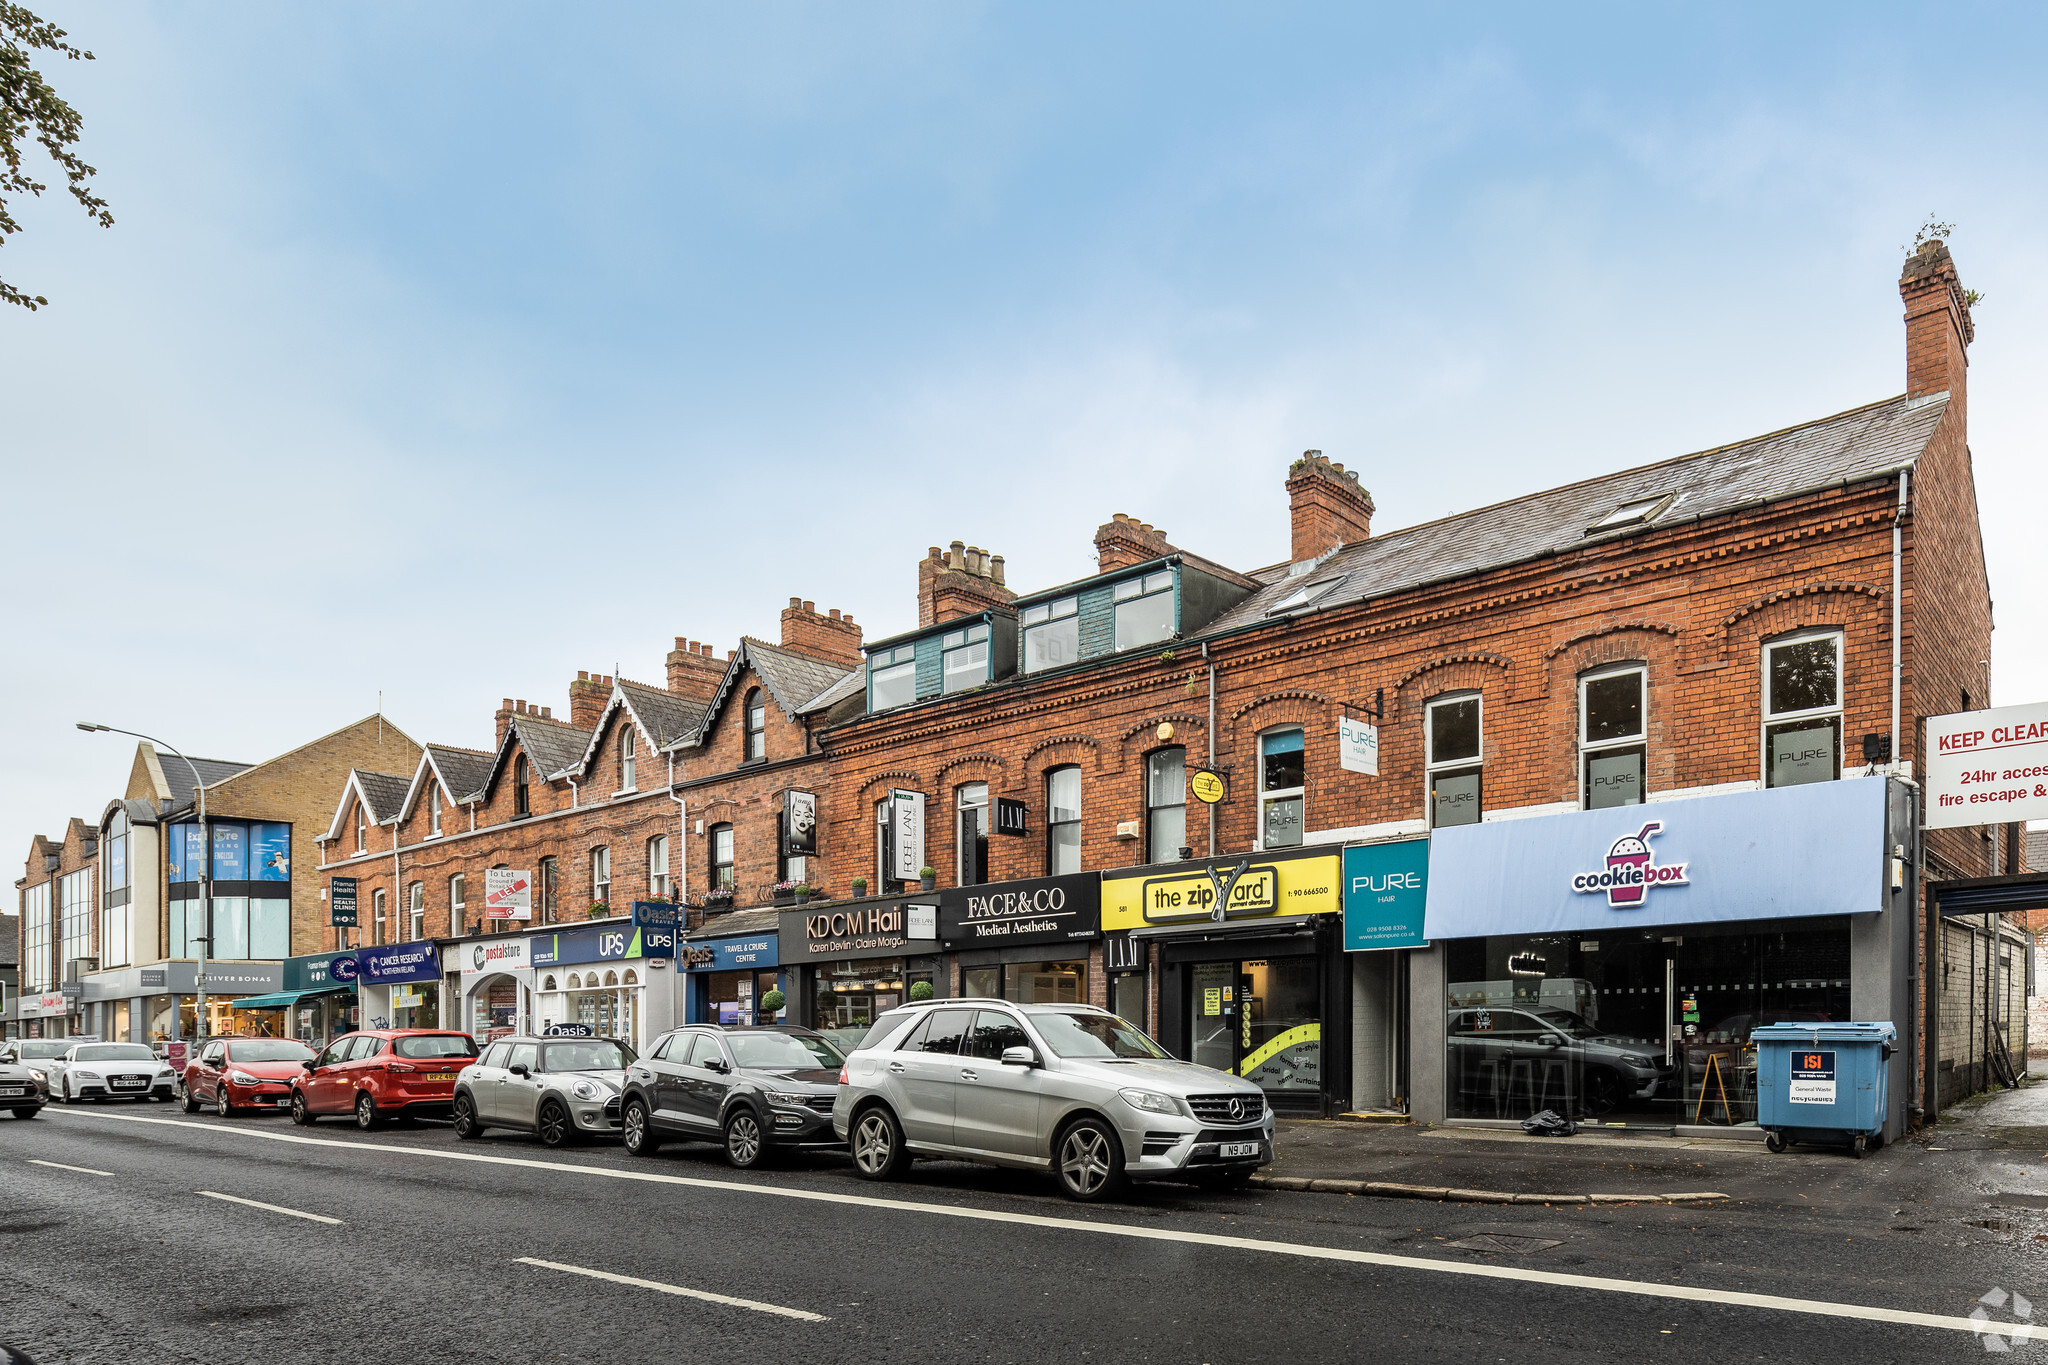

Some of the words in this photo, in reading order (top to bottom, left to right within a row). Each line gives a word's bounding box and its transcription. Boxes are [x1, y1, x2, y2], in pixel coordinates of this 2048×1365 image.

[1342, 727, 1376, 749] PURE
[1939, 730, 1985, 751] KEEP
[1991, 721, 2048, 743] CLEAR
[1353, 746, 1366, 755] HAIR
[1780, 748, 1828, 764] PURE
[1594, 773, 1636, 787] PURE
[1960, 769, 1997, 785] 24hr
[1440, 792, 1475, 805] PURE
[1939, 793, 1964, 807] fire
[1969, 787, 2028, 803] escape
[2033, 784, 2047, 797] &
[903, 804, 912, 837] LANE
[1269, 816, 1299, 826] PURE
[1352, 872, 1421, 893] PURE
[1574, 863, 1684, 889] cookiebox
[497, 884, 517, 898] LET
[1154, 887, 1181, 908] the
[1187, 884, 1214, 910] zip
[1293, 889, 1303, 897] 90
[1303, 887, 1329, 895] 666500
[967, 887, 1066, 919] FACE&CO
[1377, 895, 1396, 903] HAIR
[638, 905, 676, 924] Oasis
[1119, 905, 1128, 913] 581
[806, 911, 864, 939] KDCM
[976, 922, 1010, 937] Medical
[1012, 919, 1058, 934] Aesthetics
[599, 933, 624, 957] UPS
[646, 935, 672, 948] UPS
[724, 944, 743, 953] TRAVEL
[743, 943, 748, 952] &
[748, 942, 768, 951] CRUISE
[809, 942, 829, 953] Karen
[830, 940, 852, 951] Devlin
[855, 938, 877, 949] Claire
[380, 955, 400, 966] CANCER
[400, 953, 425, 964] RESEARCH
[680, 945, 714, 970] Oasis
[735, 954, 757, 963] CENTRE
[549, 1025, 588, 1036] Oasis
[1295, 1043, 1319, 1053] re-style
[1280, 1054, 1300, 1071] formal
[1304, 1062, 1317, 1070] zips
[1262, 1066, 1281, 1074] bridal
[1277, 1073, 1294, 1086] hems
[1295, 1077, 1320, 1087] curtains
[1228, 1145, 1239, 1156] N9
